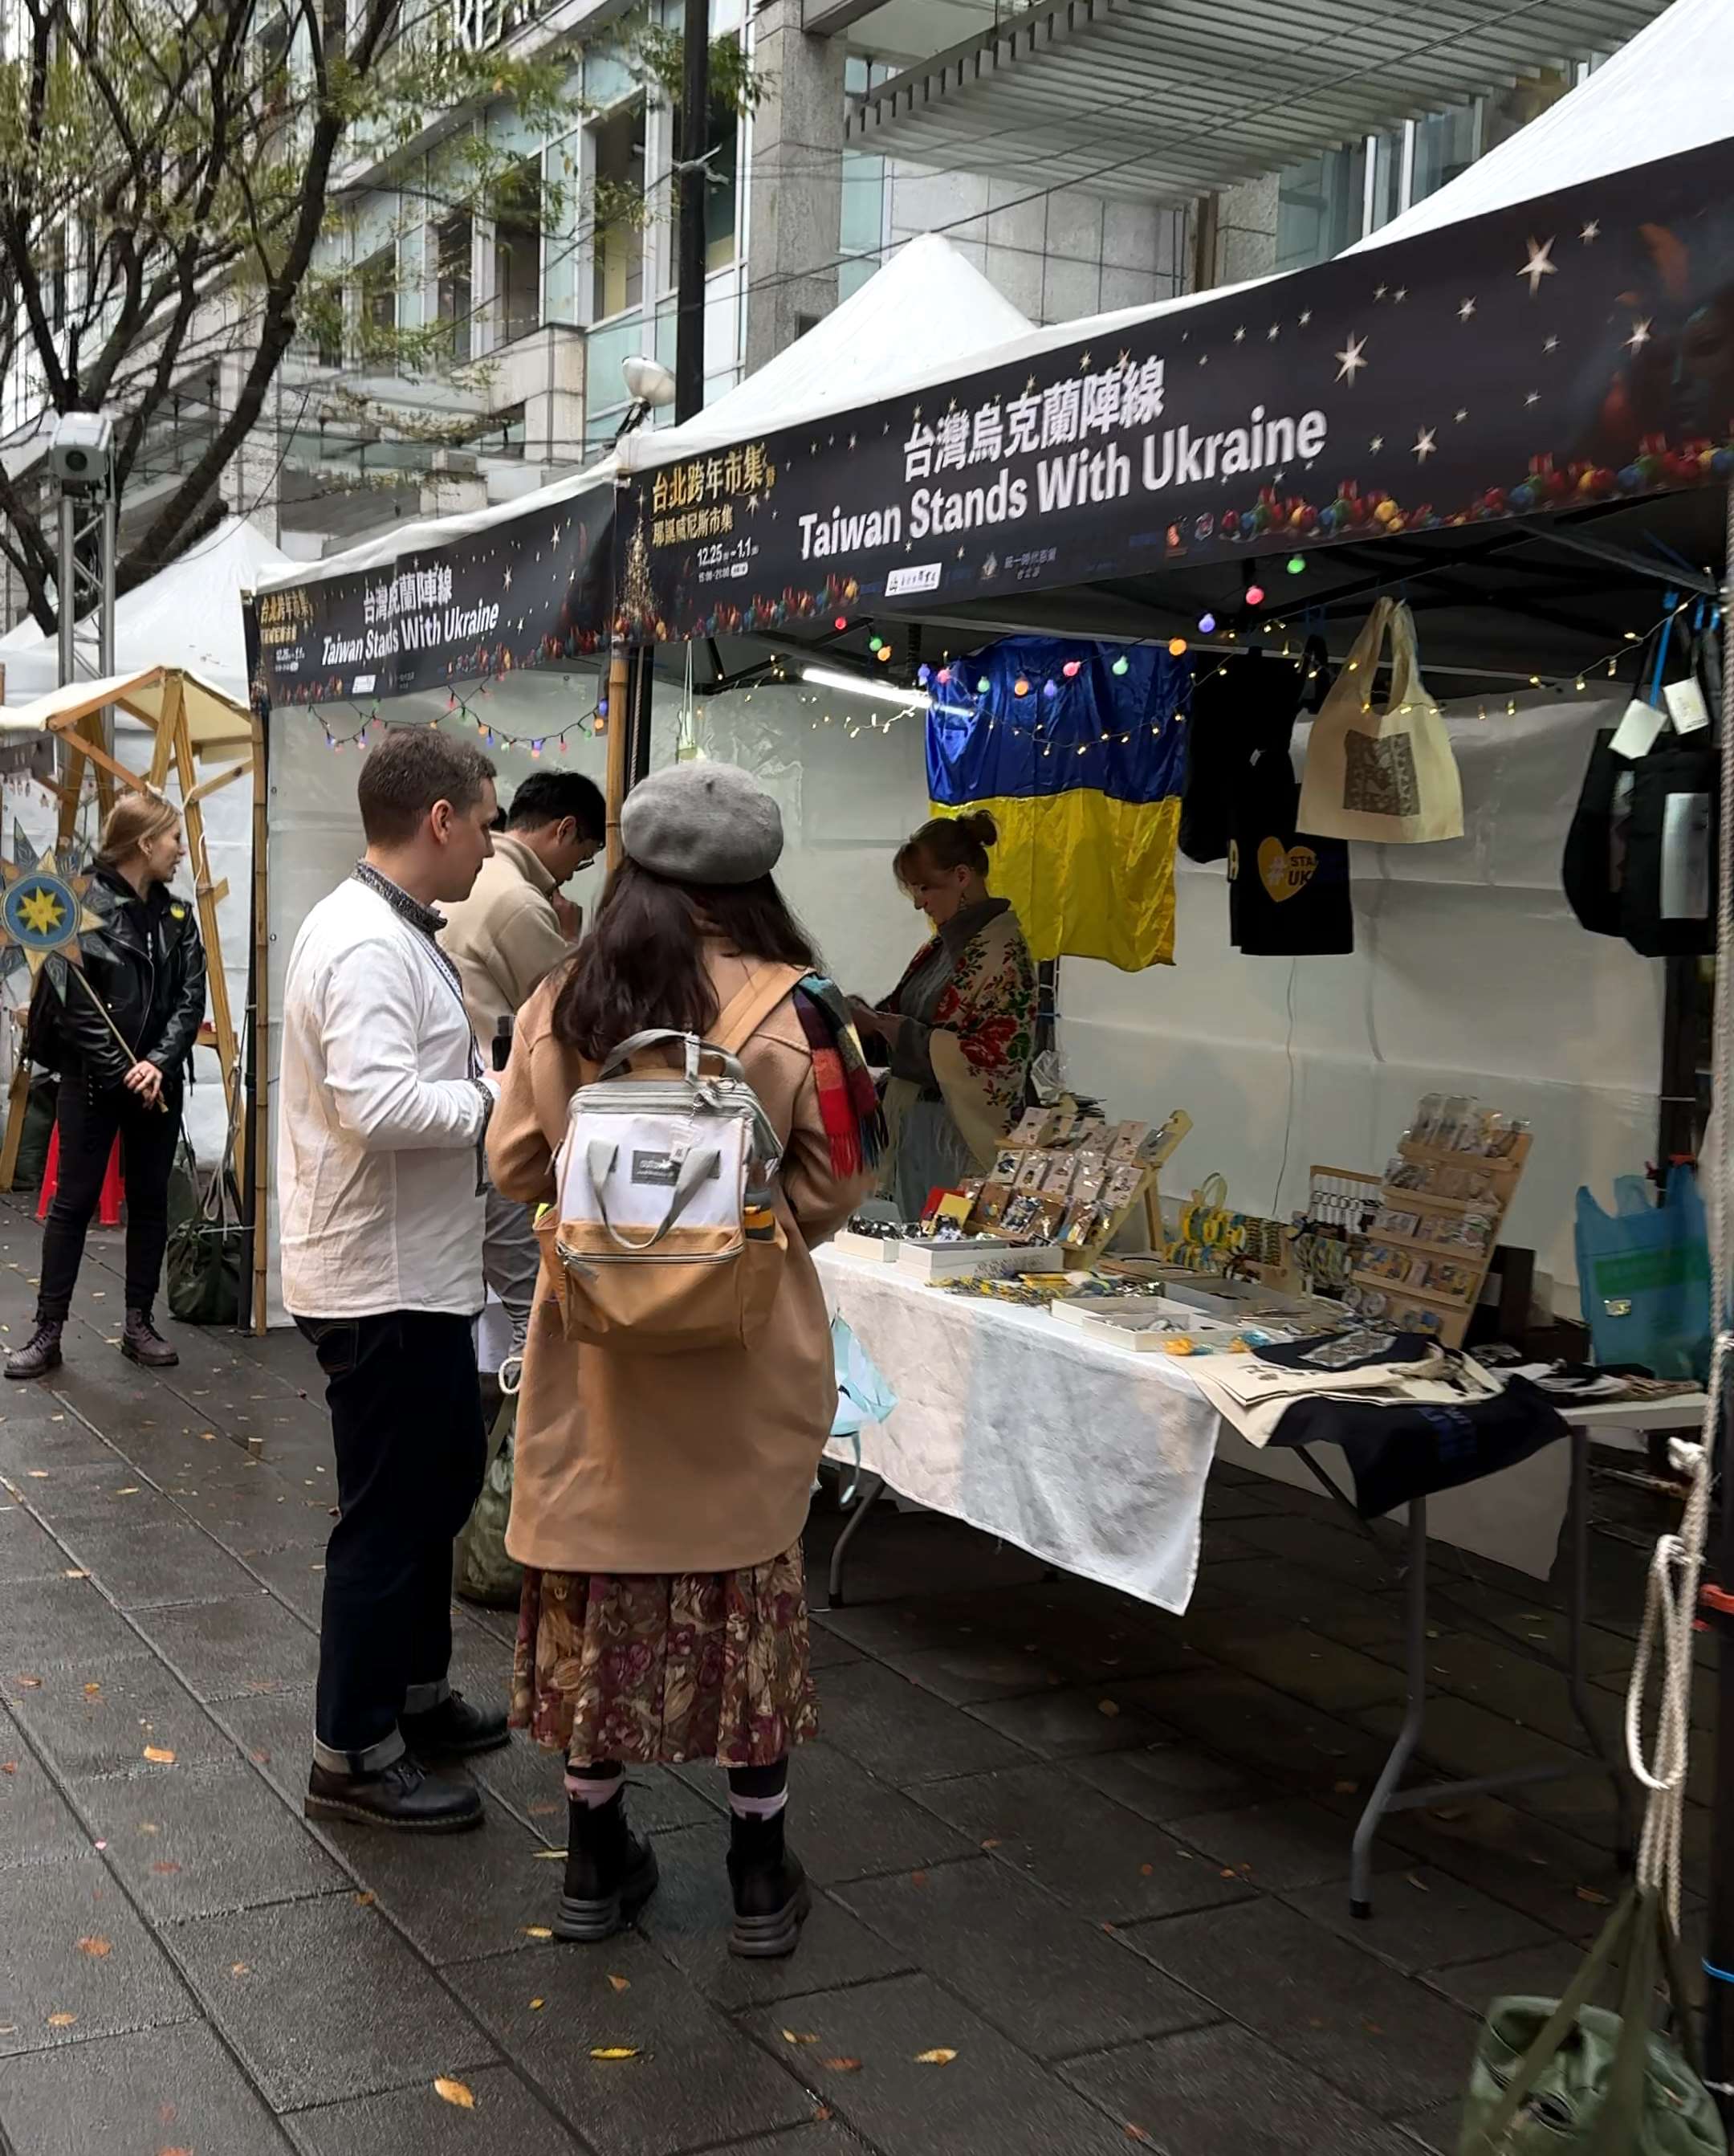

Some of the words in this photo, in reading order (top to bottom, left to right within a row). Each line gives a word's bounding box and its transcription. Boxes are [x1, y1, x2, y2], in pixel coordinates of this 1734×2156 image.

[904, 355, 1165, 482] 台灣烏克蘭陣線
[653, 445, 763, 513] 台北跨年市集
[799, 508, 901, 560] Taiwan
[910, 469, 1028, 540] Stands
[1037, 443, 1130, 514] With
[1142, 405, 1327, 491] Ukraine
[322, 631, 364, 666] Taiwan
[401, 612, 442, 651] With
[444, 598, 499, 642] Ukraine
